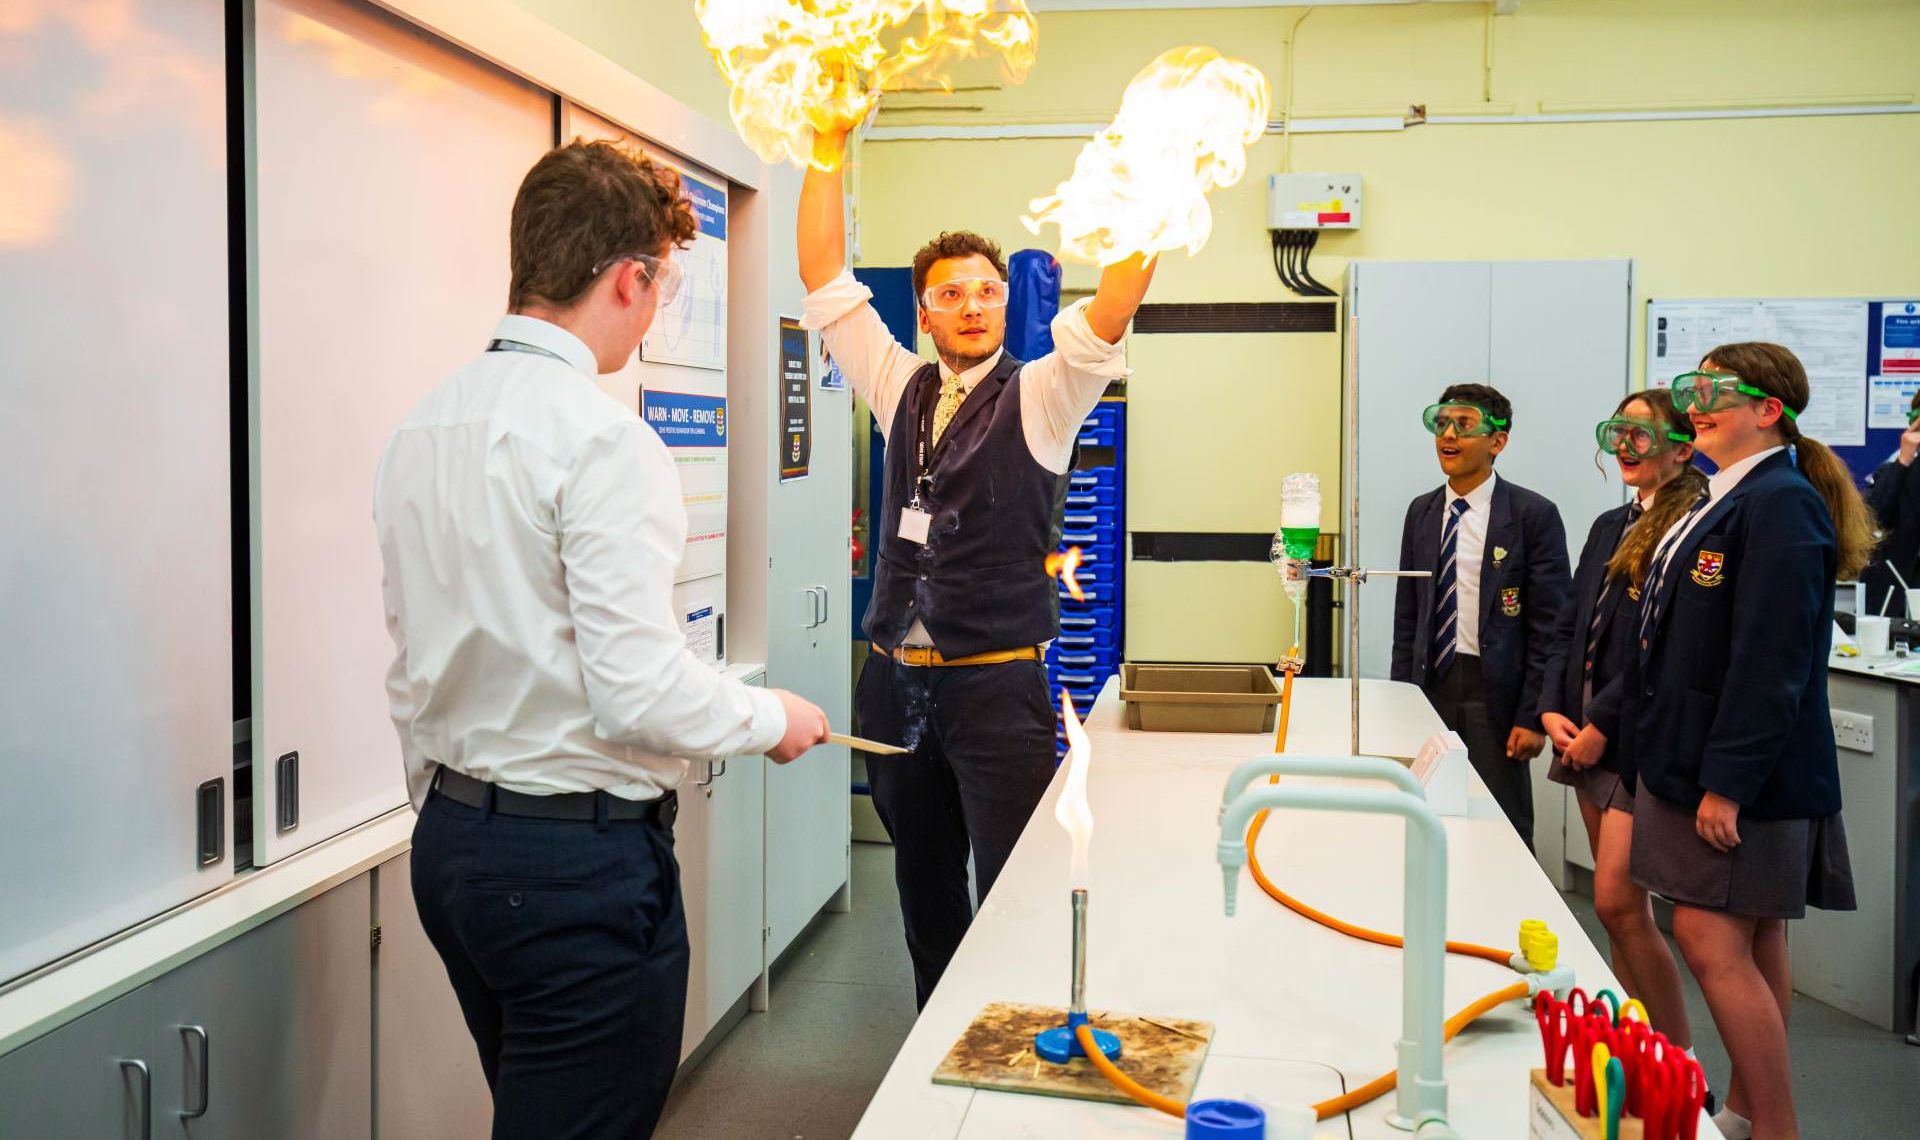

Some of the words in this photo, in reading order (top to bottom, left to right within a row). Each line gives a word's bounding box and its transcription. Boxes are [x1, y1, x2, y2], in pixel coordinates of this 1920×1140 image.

[647, 406, 667, 422] WARN
[671, 408, 689, 423] MOVE
[692, 409, 716, 424] REMOVE
